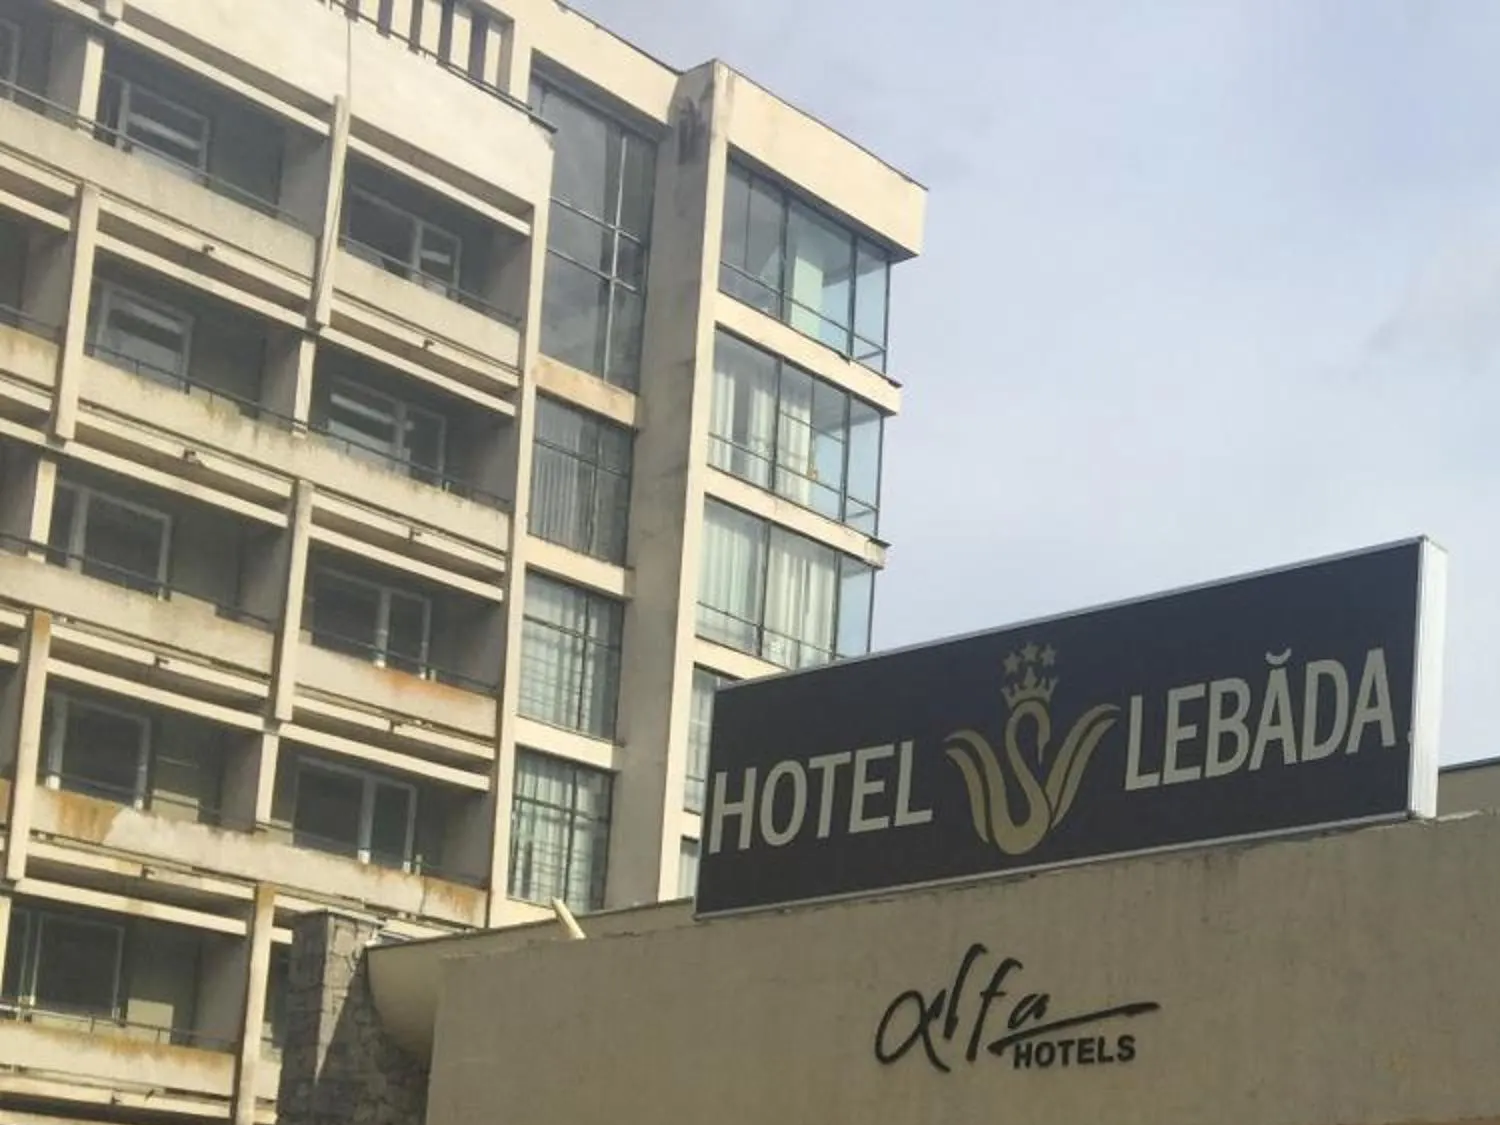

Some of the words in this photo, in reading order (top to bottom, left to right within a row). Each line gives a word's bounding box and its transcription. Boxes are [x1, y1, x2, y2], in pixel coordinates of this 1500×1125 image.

[708, 741, 933, 855] HOTEL
[1125, 646, 1396, 792] LEBĂDA
[1013, 1035, 1136, 1069] HOTELS
